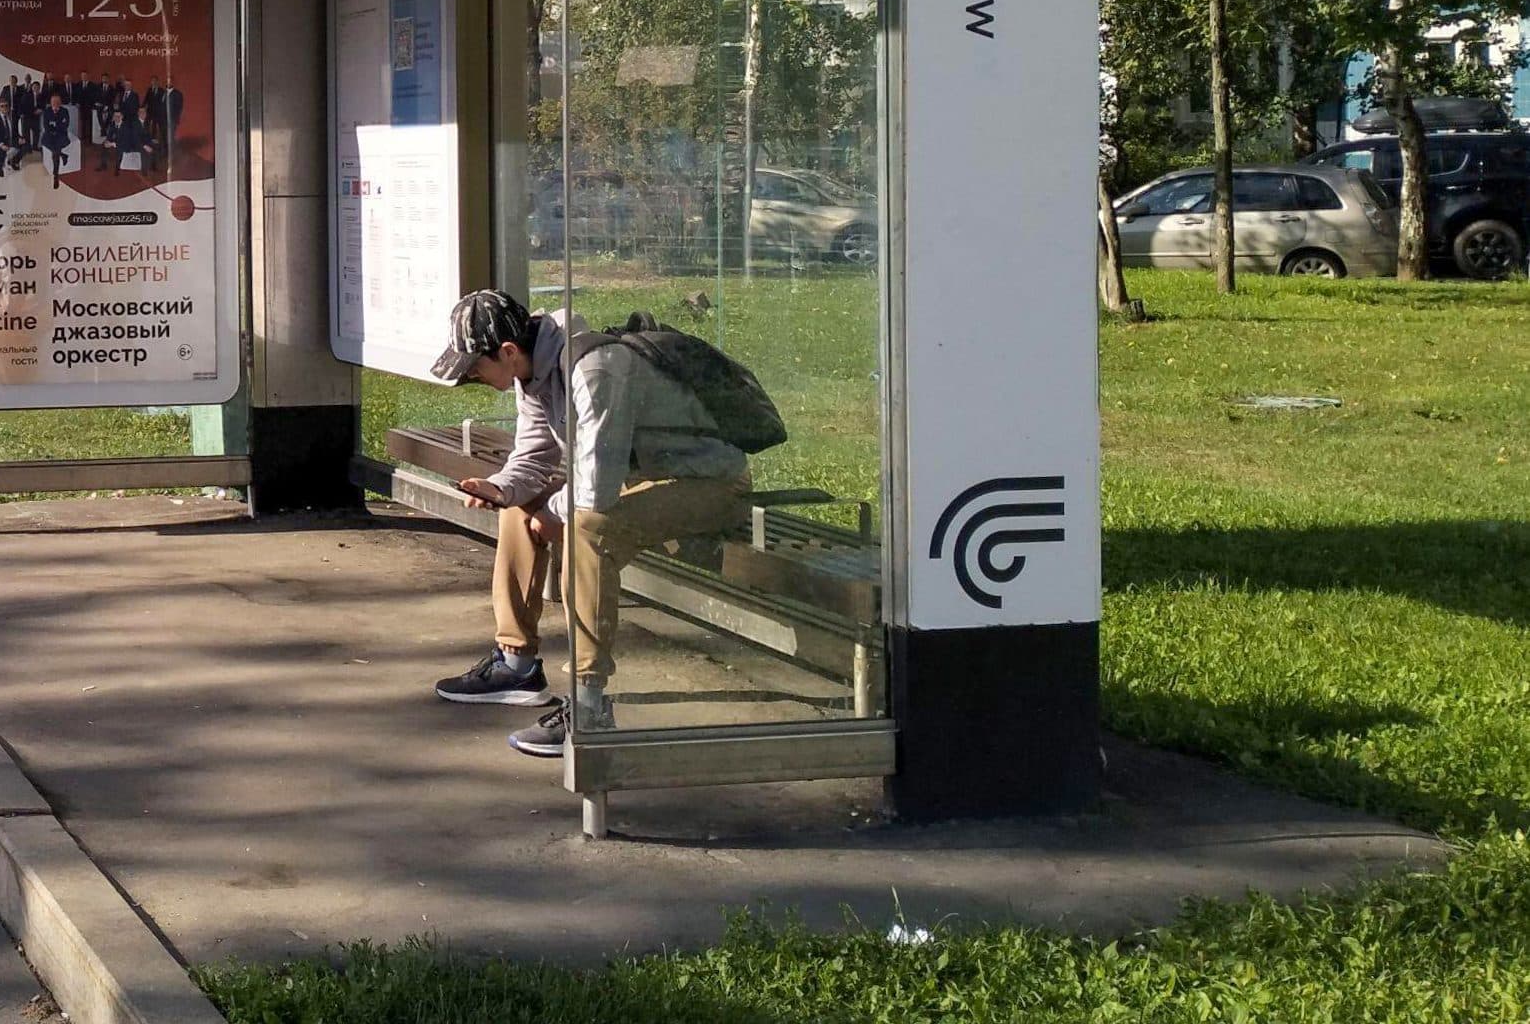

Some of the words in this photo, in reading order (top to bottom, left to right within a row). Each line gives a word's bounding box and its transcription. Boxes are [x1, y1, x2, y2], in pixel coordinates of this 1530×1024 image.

[21, 35, 35, 44] 25
[37, 35, 55, 43] лет
[59, 34, 134, 45] прославляем
[99, 49, 112, 57] во
[116, 49, 144, 57] всем
[50, 242, 191, 263] ЮБИЛЕЙНЫЕ
[50, 266, 168, 284] КОНЦЕРТЫ
[52, 296, 193, 317] Московский
[52, 320, 170, 344] джазовый
[52, 348, 148, 369] оркестр
[179, 347, 191, 357] 6+
